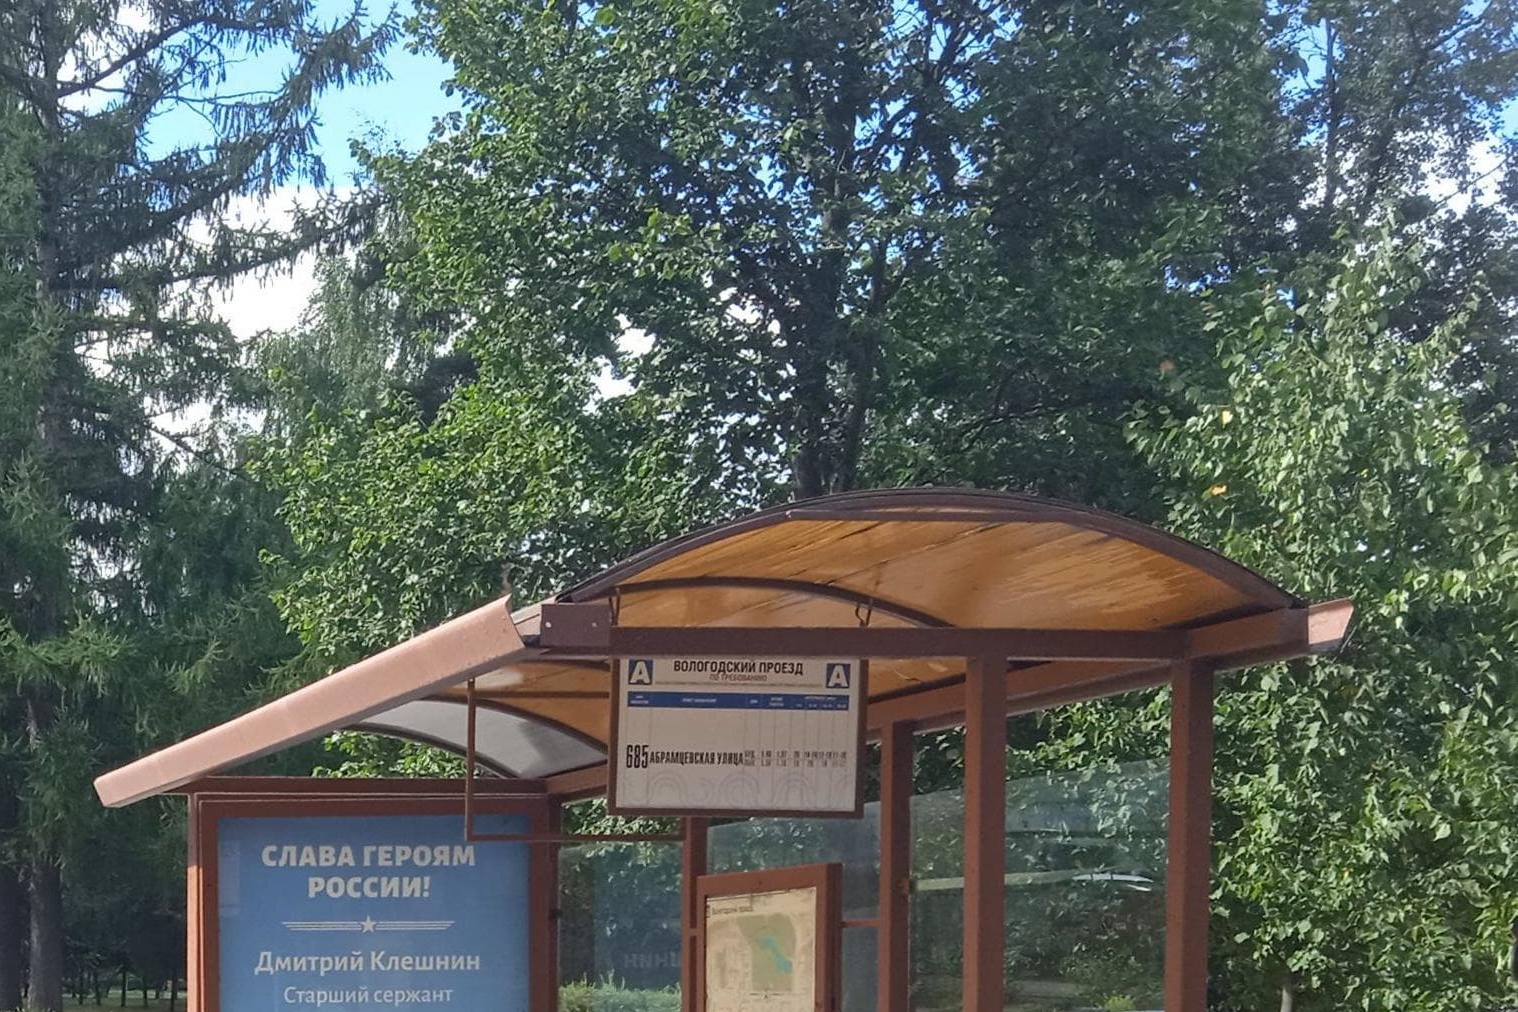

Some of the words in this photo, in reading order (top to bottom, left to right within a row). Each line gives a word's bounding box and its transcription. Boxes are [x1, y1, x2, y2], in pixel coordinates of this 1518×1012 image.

[674, 659, 756, 675] ВОЛОГОДСКИЙ
[759, 662, 803, 676] ПРОЕЗД
[626, 745, 649, 769] 685
[649, 751, 715, 765] АБРАМЦЕВСКАЯ
[717, 752, 743, 766] УЛИЦА
[262, 845, 356, 867] СЛАВА
[363, 845, 475, 867] ГЕРОЯМ
[308, 876, 430, 898] РОССИИ!
[254, 950, 363, 976] Дмитрий
[370, 951, 480, 972] Клешнин
[284, 986, 369, 1007] Старший
[374, 987, 453, 1007] сержант
